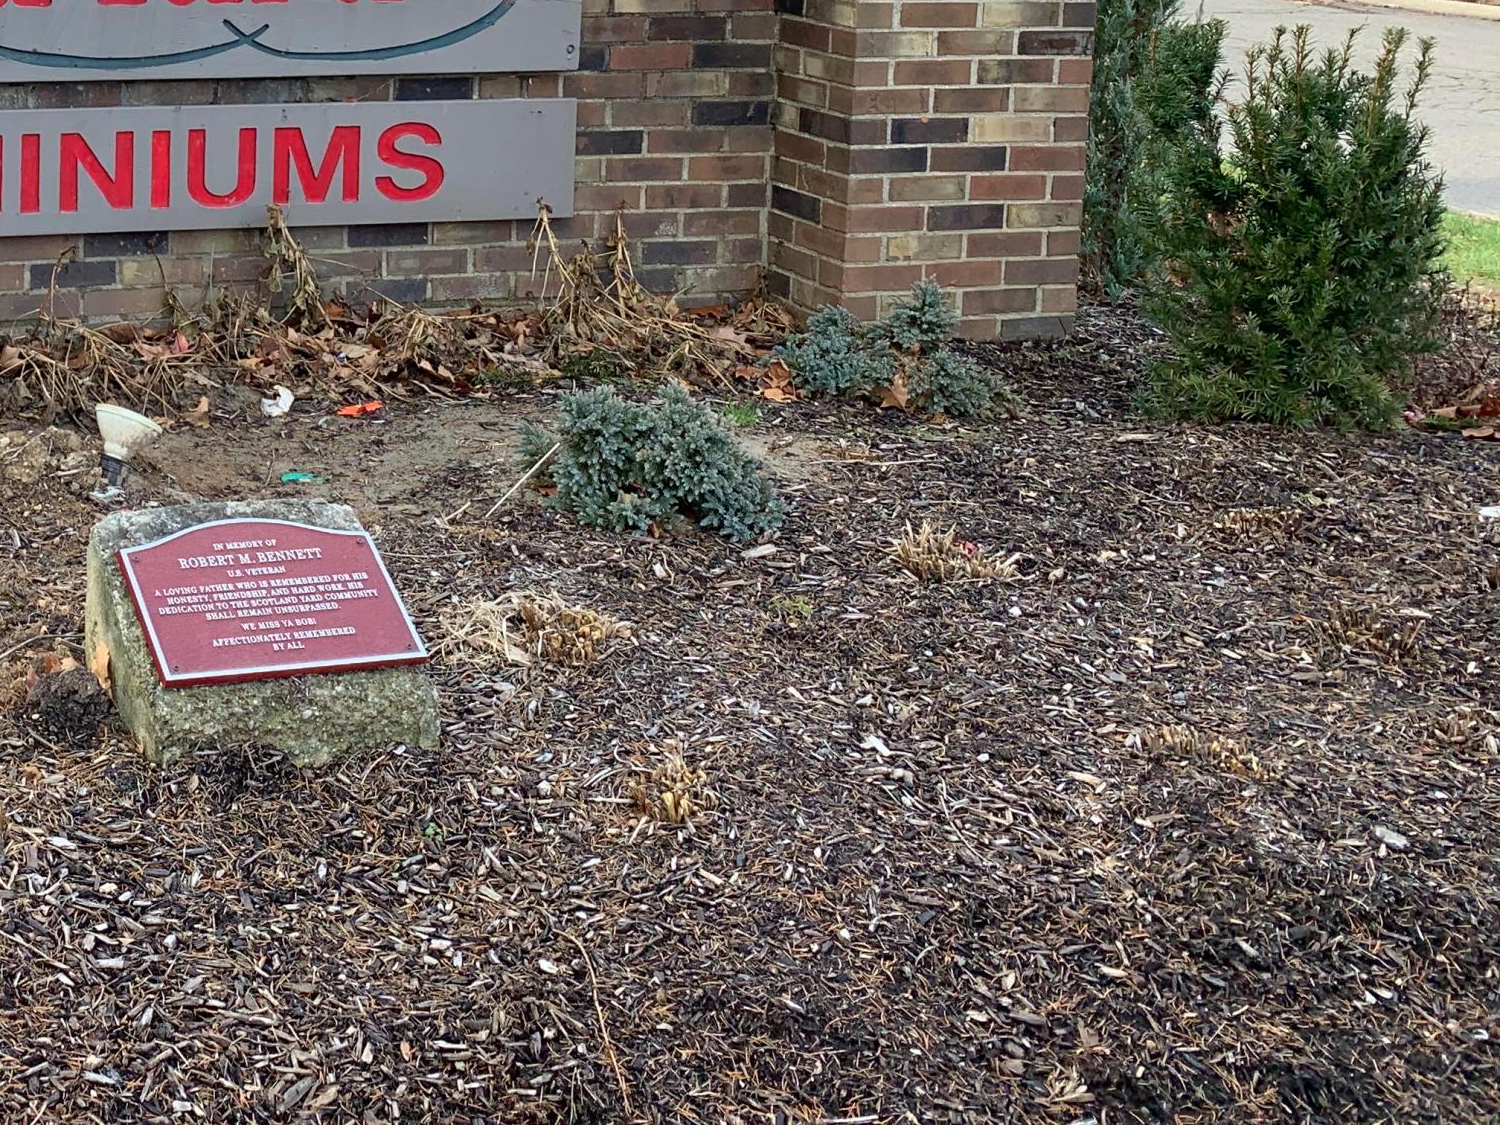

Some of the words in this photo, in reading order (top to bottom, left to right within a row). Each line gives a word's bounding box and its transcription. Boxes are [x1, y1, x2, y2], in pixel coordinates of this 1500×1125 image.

[212, 543, 225, 551] IN
[226, 539, 263, 550] MEMORY
[265, 539, 277, 547] OF
[178, 554, 236, 569] ROBERT
[237, 553, 256, 565] M.
[256, 547, 323, 563] BENNETT
[246, 565, 286, 575] VETERAN
[155, 589, 162, 597] A
[163, 585, 198, 596] LOVING
[199, 583, 235, 591] FATHER
[236, 581, 257, 590] WHO
[259, 579, 269, 588] IS
[270, 575, 331, 587] REMEMBERED
[332, 573, 350, 582] FOR
[352, 571, 369, 580] HIS
[166, 594, 213, 605] HONESTY,
[270, 587, 290, 597] AND
[290, 585, 316, 595] HARD
[347, 581, 364, 590] HIS
[158, 603, 215, 615] DEDICATION
[216, 602, 228, 611] TO
[229, 599, 250, 609] THE
[250, 595, 298, 607] SCOTLAND
[298, 593, 323, 603] YARD
[324, 589, 379, 601] COMMUNITY
[206, 612, 236, 621] SHALL
[236, 607, 273, 617] REMAIN
[274, 601, 342, 615] UNSURPASSED.
[240, 622, 257, 631] WE
[258, 619, 280, 630] MISS
[281, 619, 294, 627] YA
[212, 632, 292, 647] AFFECTIONATELY
[292, 626, 356, 640] REMEMBERED
[272, 643, 285, 651] BY
[286, 641, 306, 649] ALL
